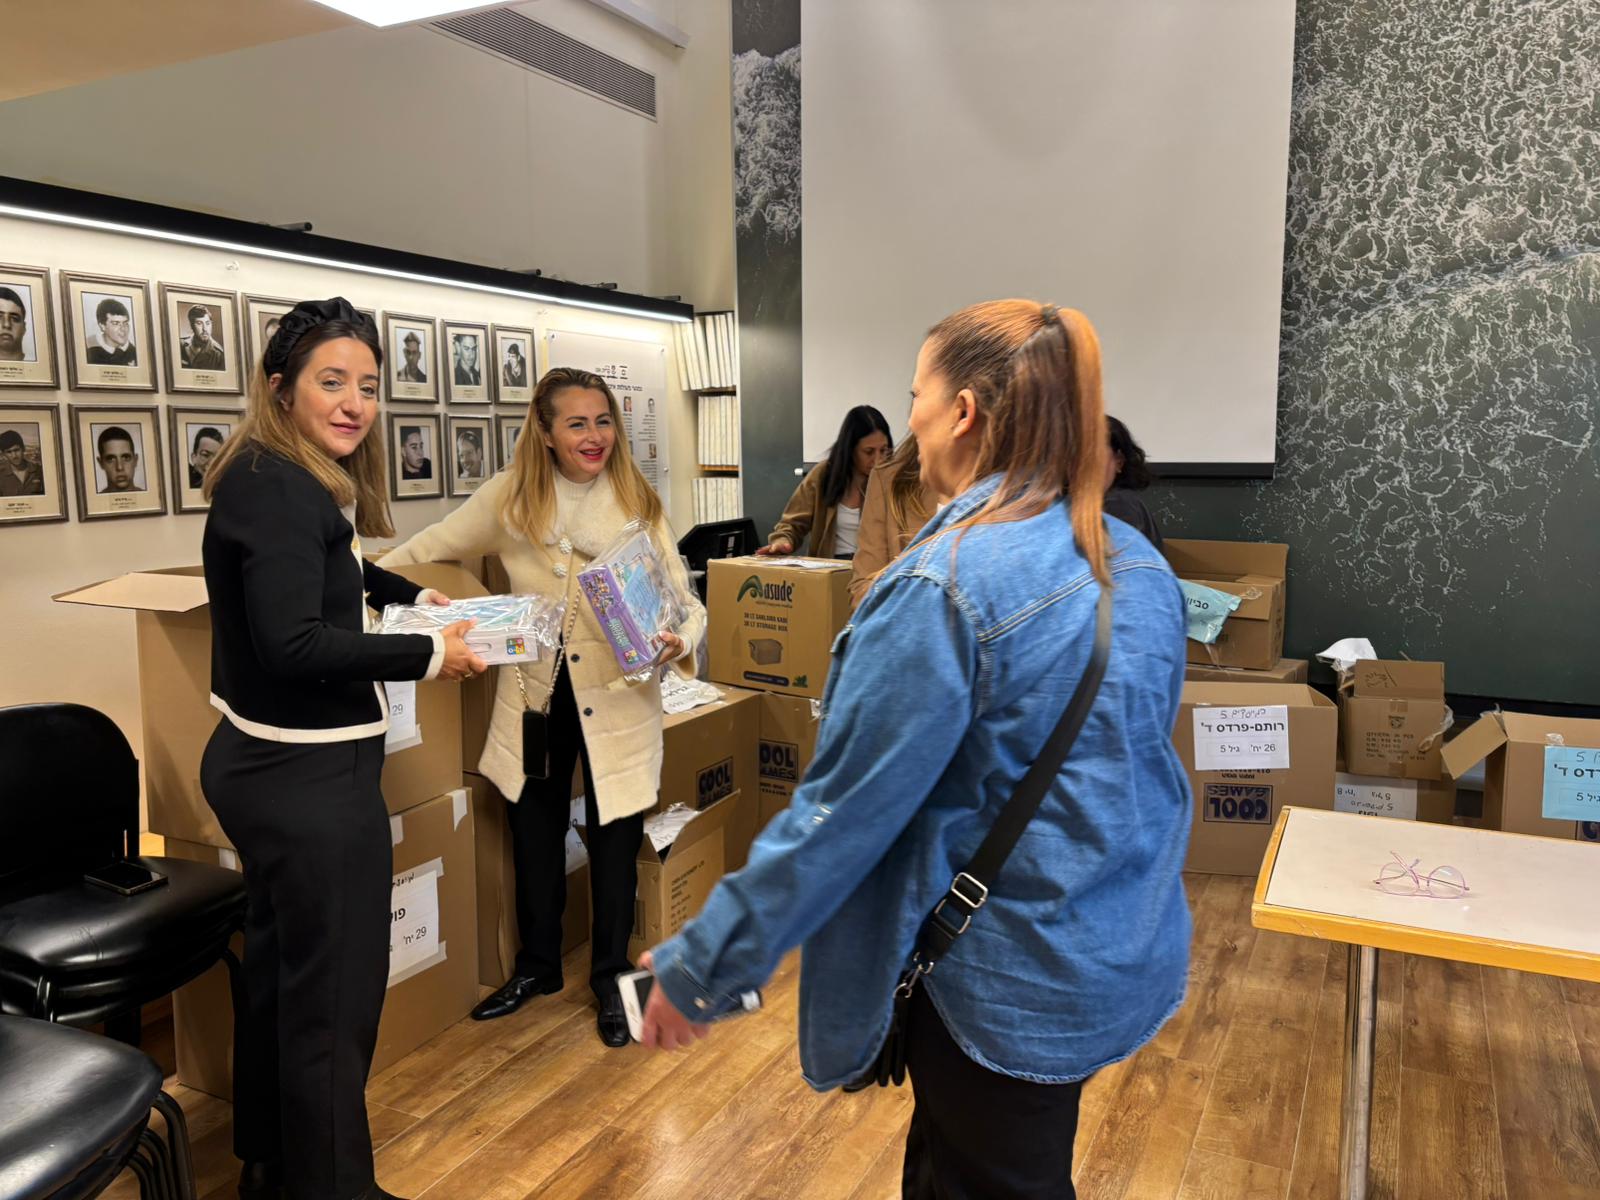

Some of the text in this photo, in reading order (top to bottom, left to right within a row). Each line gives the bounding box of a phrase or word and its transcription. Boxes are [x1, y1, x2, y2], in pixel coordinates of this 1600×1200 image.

[392, 704, 404, 717] 29
[1216, 722, 1285, 733] רותם-פרדס
[1220, 744, 1226, 753] 5
[1228, 745, 1240, 753] גיל
[1264, 743, 1276, 753] 26
[760, 743, 795, 768] OOL
[1576, 792, 1584, 801] 5
[1209, 797, 1268, 820] COOL
[415, 926, 427, 941] 29
